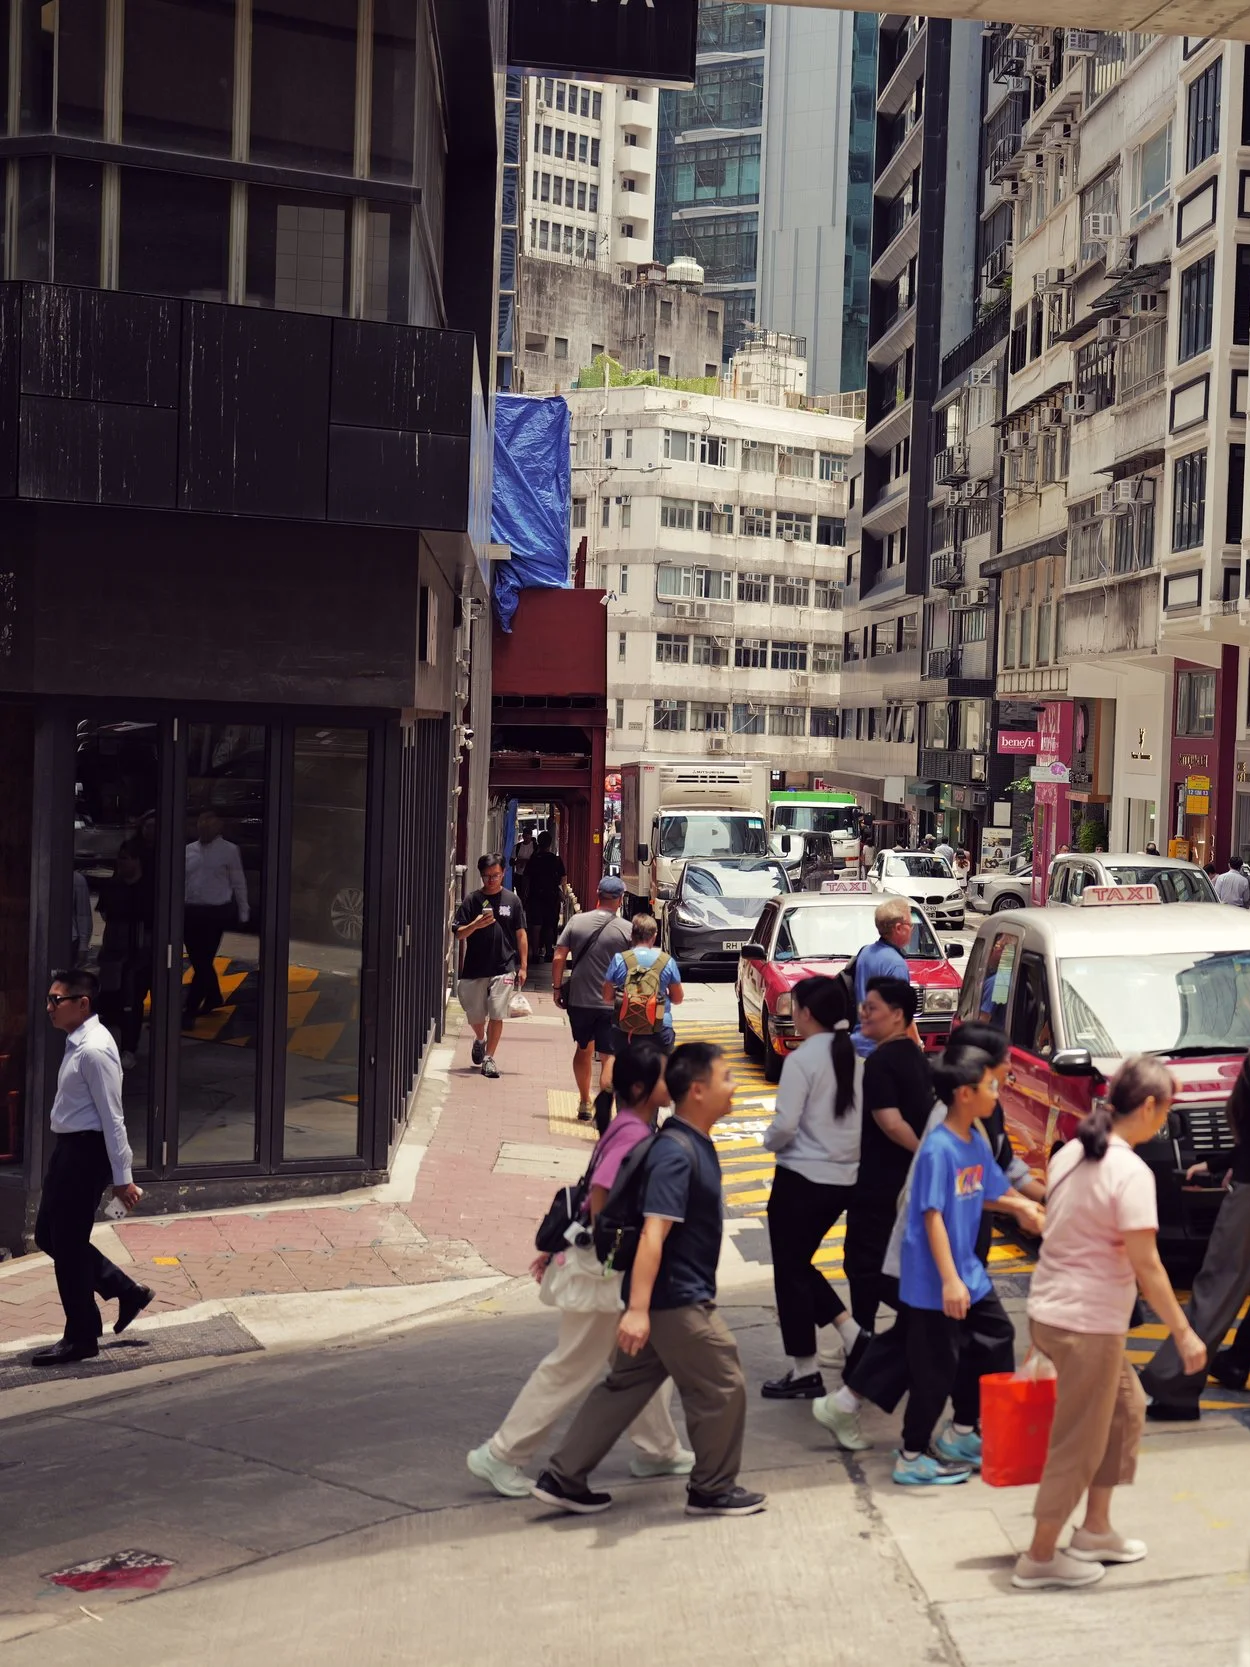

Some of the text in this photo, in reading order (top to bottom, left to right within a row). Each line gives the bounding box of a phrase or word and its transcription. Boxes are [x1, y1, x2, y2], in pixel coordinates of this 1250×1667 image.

[1001, 736, 1035, 749] benefit
[827, 882, 867, 891] TAXI
[1092, 886, 1153, 901] TAXI
